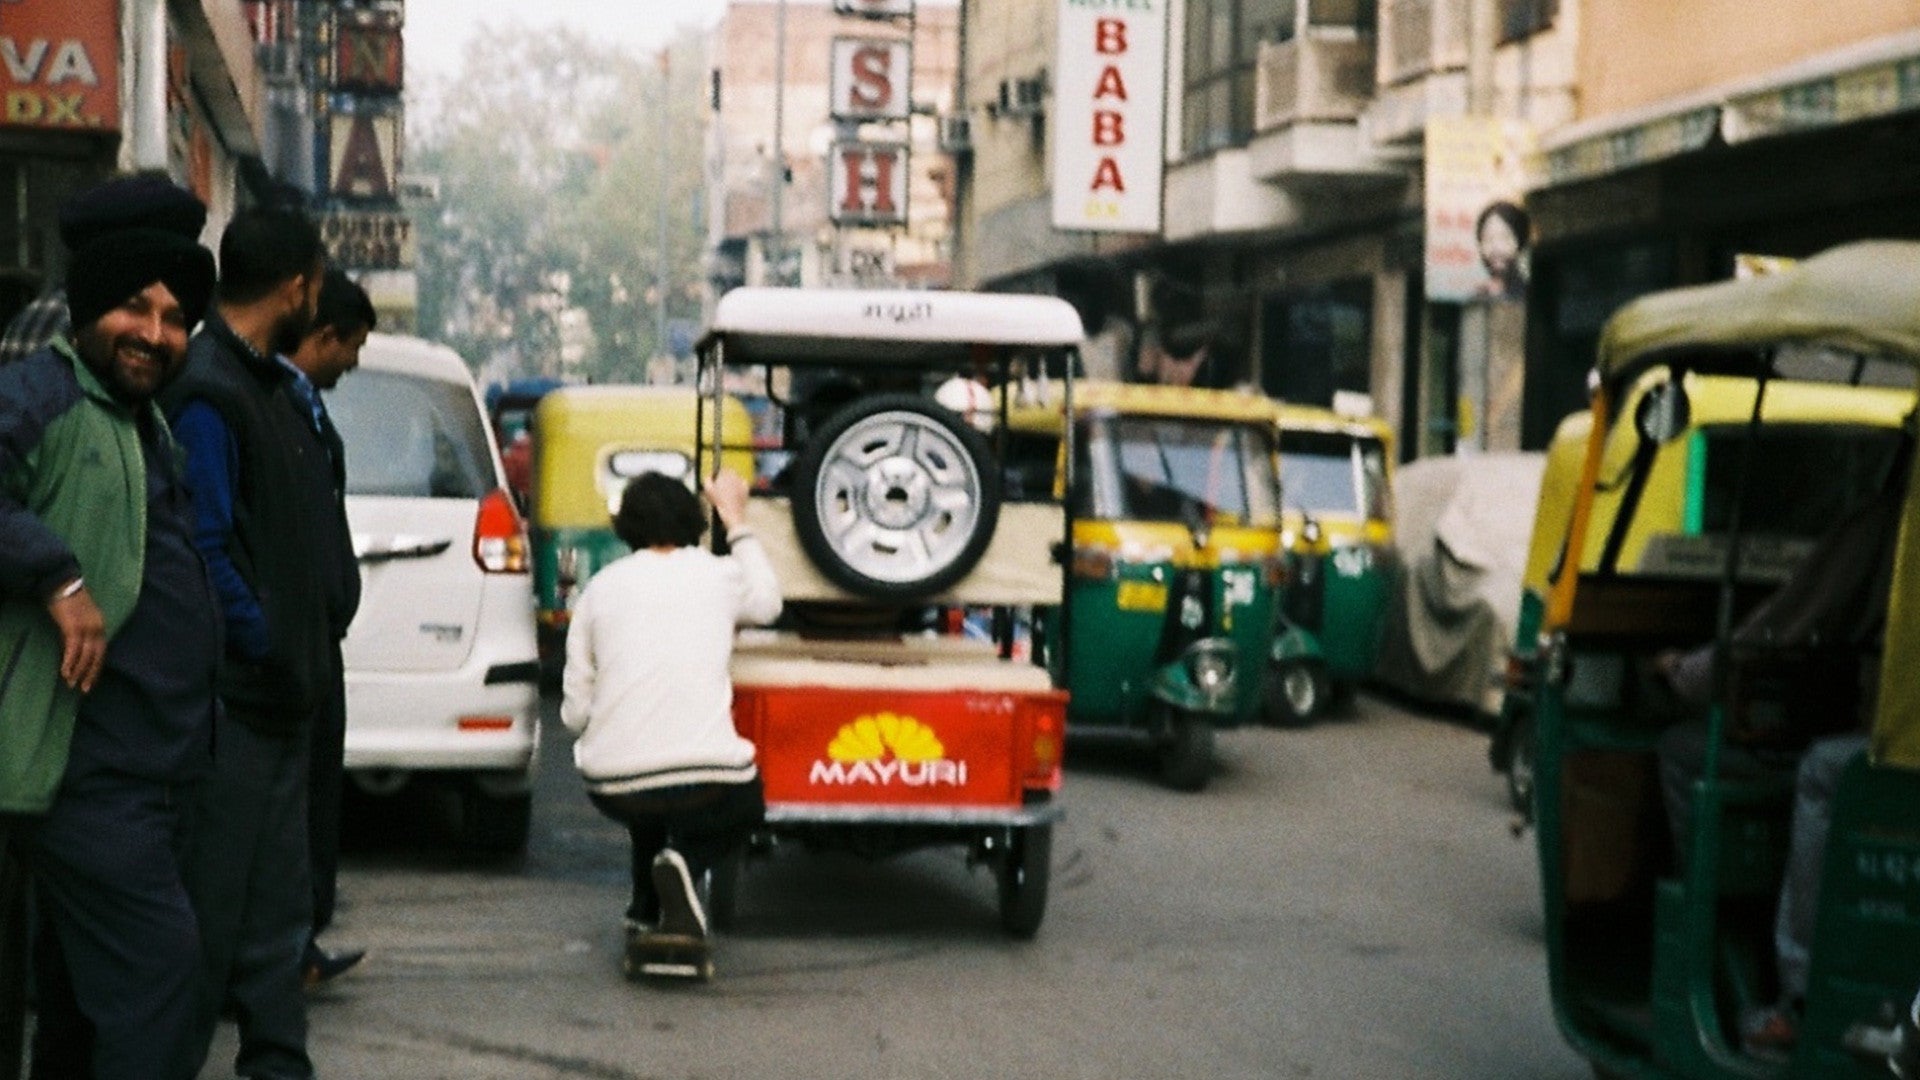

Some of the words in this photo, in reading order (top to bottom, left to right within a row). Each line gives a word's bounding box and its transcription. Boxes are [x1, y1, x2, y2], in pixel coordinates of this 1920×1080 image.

[0, 37, 99, 86] VA
[1091, 19, 1127, 192] BABA
[809, 758, 967, 787] MAYURI
